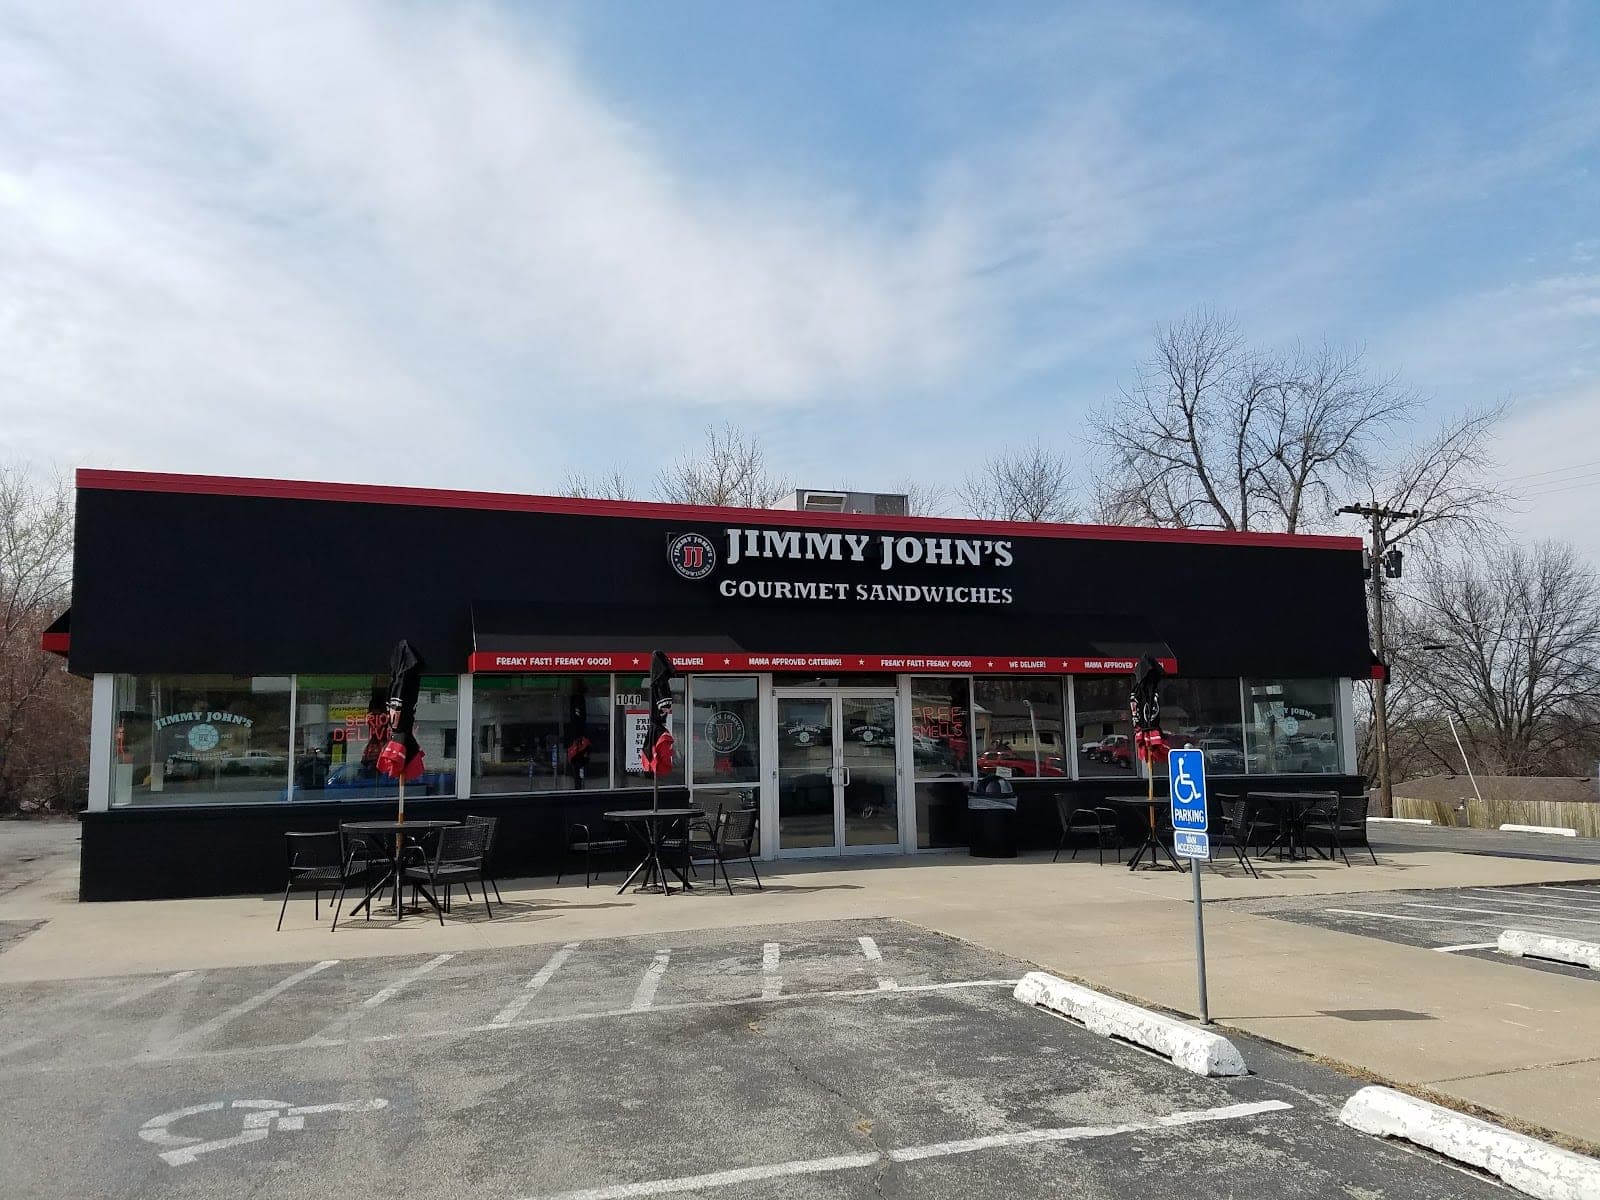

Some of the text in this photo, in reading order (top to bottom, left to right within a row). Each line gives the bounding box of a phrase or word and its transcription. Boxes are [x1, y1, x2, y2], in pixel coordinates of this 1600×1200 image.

[727, 529, 1013, 570] JIMMY JOHN'S
[683, 546, 703, 567] JJ
[720, 580, 1013, 604] GOURMET SANDWICHES
[496, 657, 611, 666] FREAKY FAST! FREAKY GOOD!
[673, 657, 704, 666] DELIVER!
[749, 657, 842, 667] MAMA APPROVED CATERING!
[881, 659, 972, 668] FREAKY FAST! FREAKY GOOD!
[1009, 660, 1046, 669] WE DELIVER!
[1084, 661, 1102, 669] MAMA
[1104, 661, 1133, 670] APPROVED
[617, 695, 641, 705] 1040
[154, 711, 254, 731] JIMMY JOHN'S
[912, 723, 962, 738] SMELLS
[1174, 808, 1205, 823] PARKING
